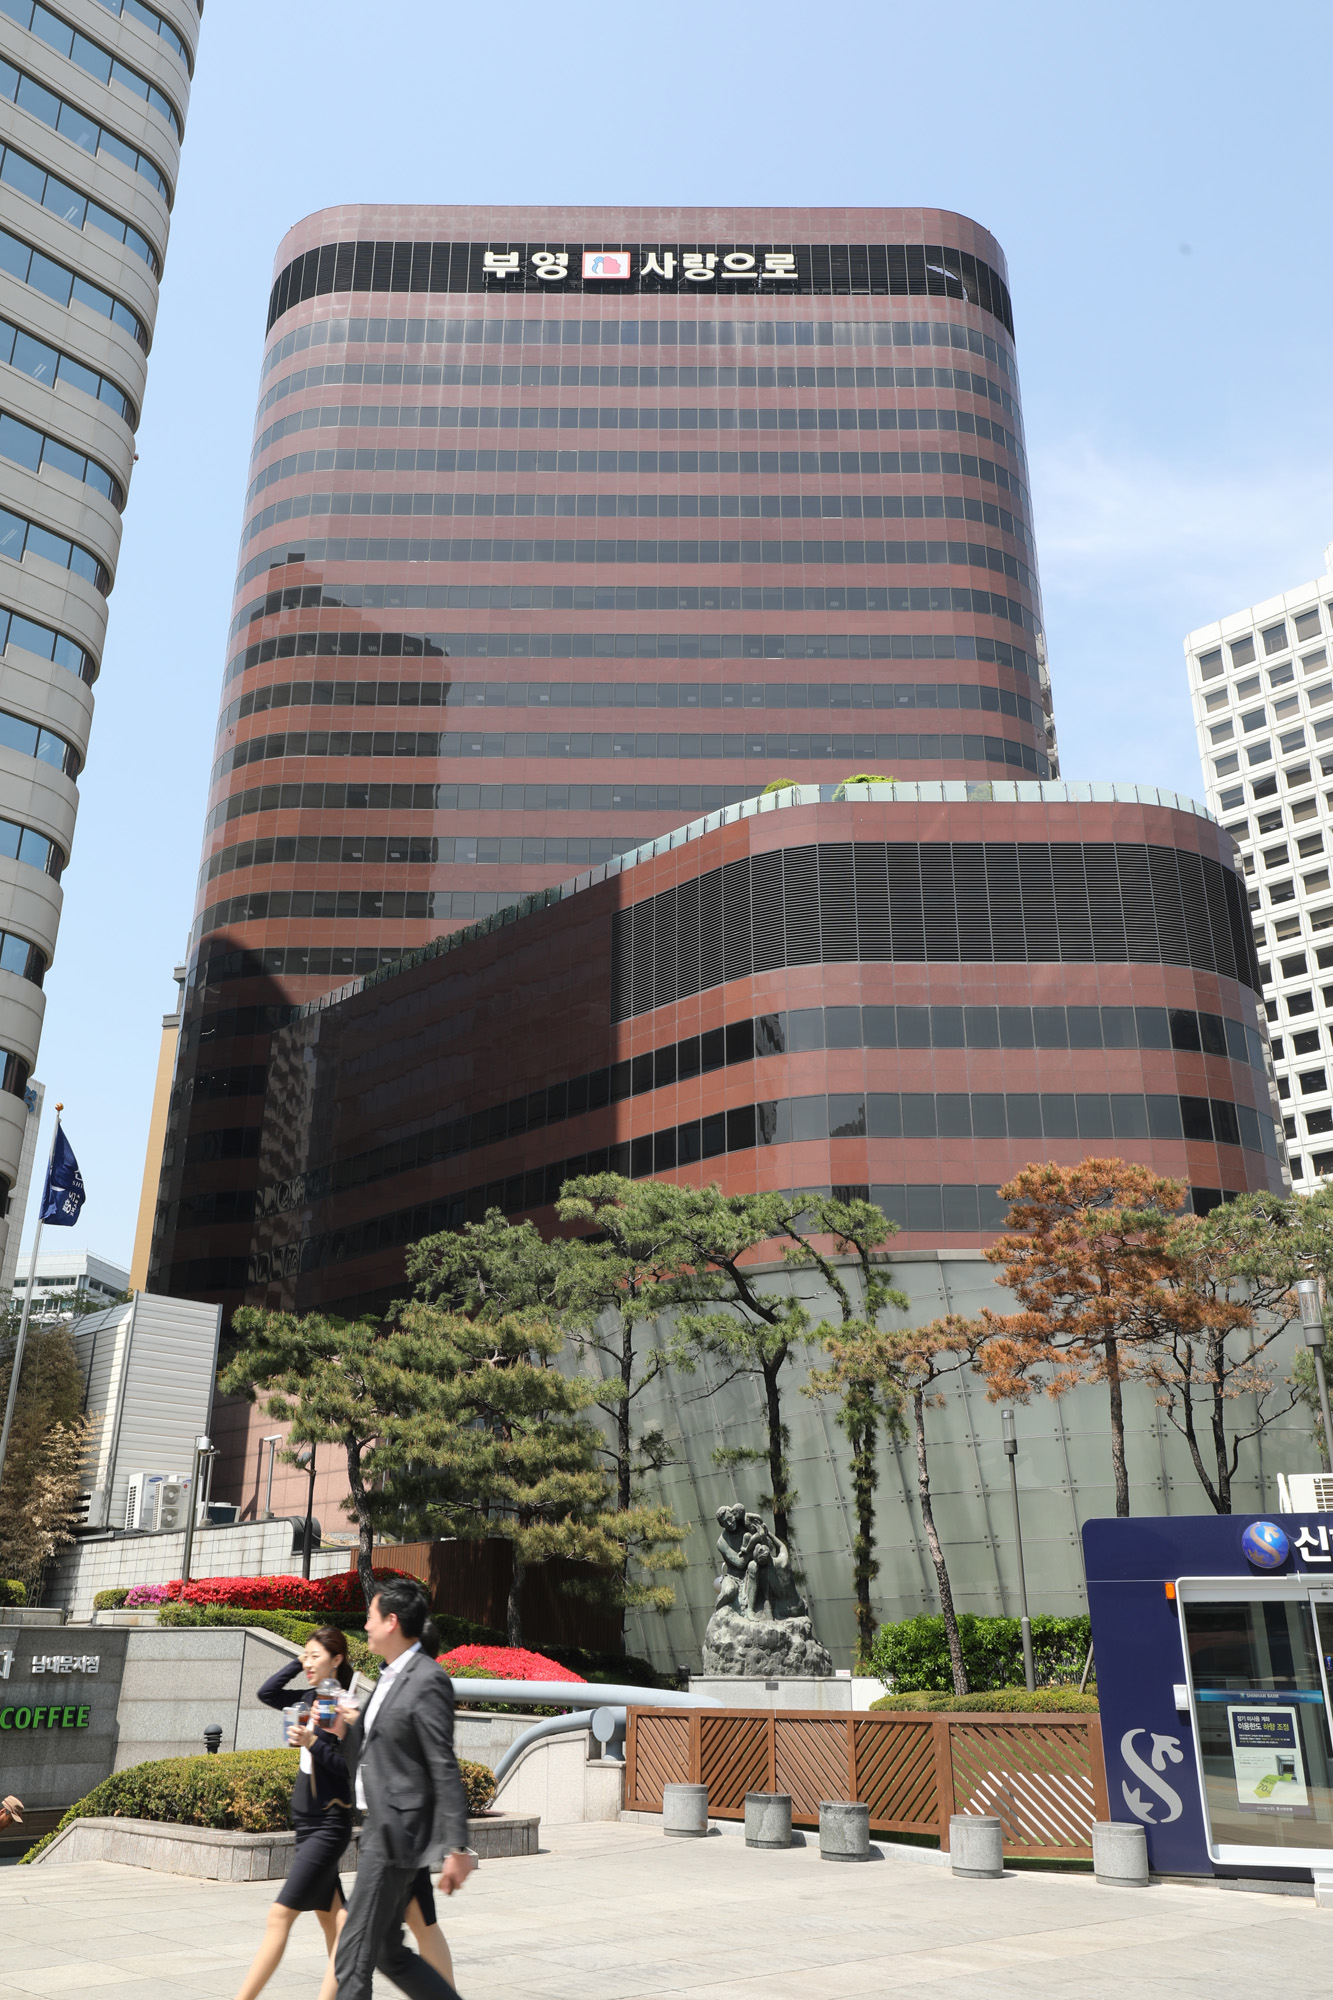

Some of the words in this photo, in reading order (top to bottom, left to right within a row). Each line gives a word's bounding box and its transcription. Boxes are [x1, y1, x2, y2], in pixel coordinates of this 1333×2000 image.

[482, 251, 569, 280] 부영
[640, 252, 798, 280] 사랑으로
[1293, 1525, 1333, 1562] 신
[31, 1655, 100, 1674] 남대문지점
[0, 1706, 91, 1729] COFFEE
[1238, 1723, 1262, 1731] 이용한도
